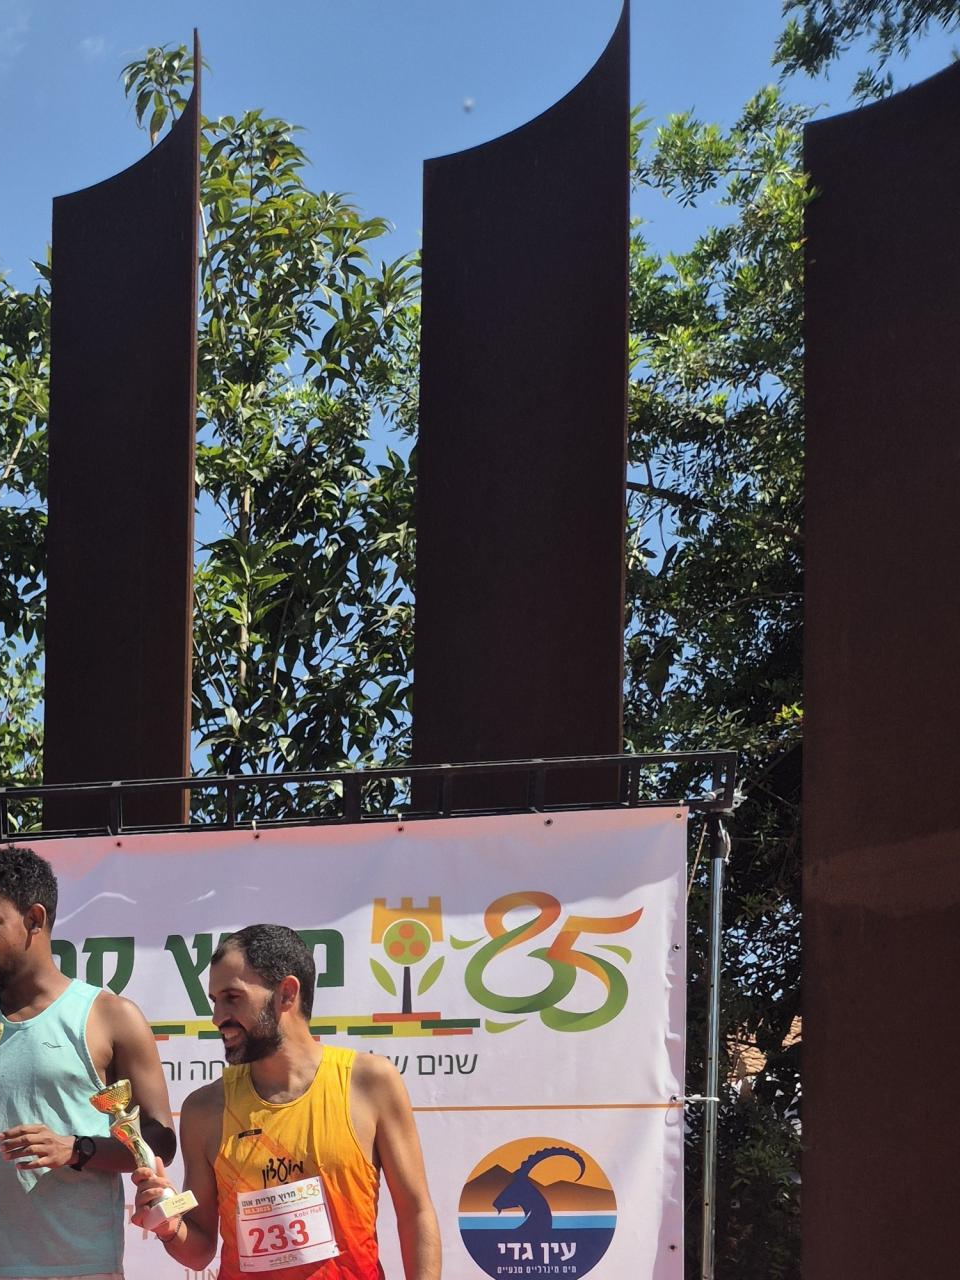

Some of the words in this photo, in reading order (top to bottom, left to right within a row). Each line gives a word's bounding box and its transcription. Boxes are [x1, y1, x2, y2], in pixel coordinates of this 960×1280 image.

[464, 891, 644, 1032] 85
[417, 1054, 478, 1075] שנים
[255, 1195, 276, 1205] קריית
[278, 1190, 296, 1202] מרוץ
[248, 1219, 309, 1254] 233
[497, 1242, 533, 1260] גדי
[540, 1242, 577, 1264] עין
[562, 1265, 577, 1273] מים
